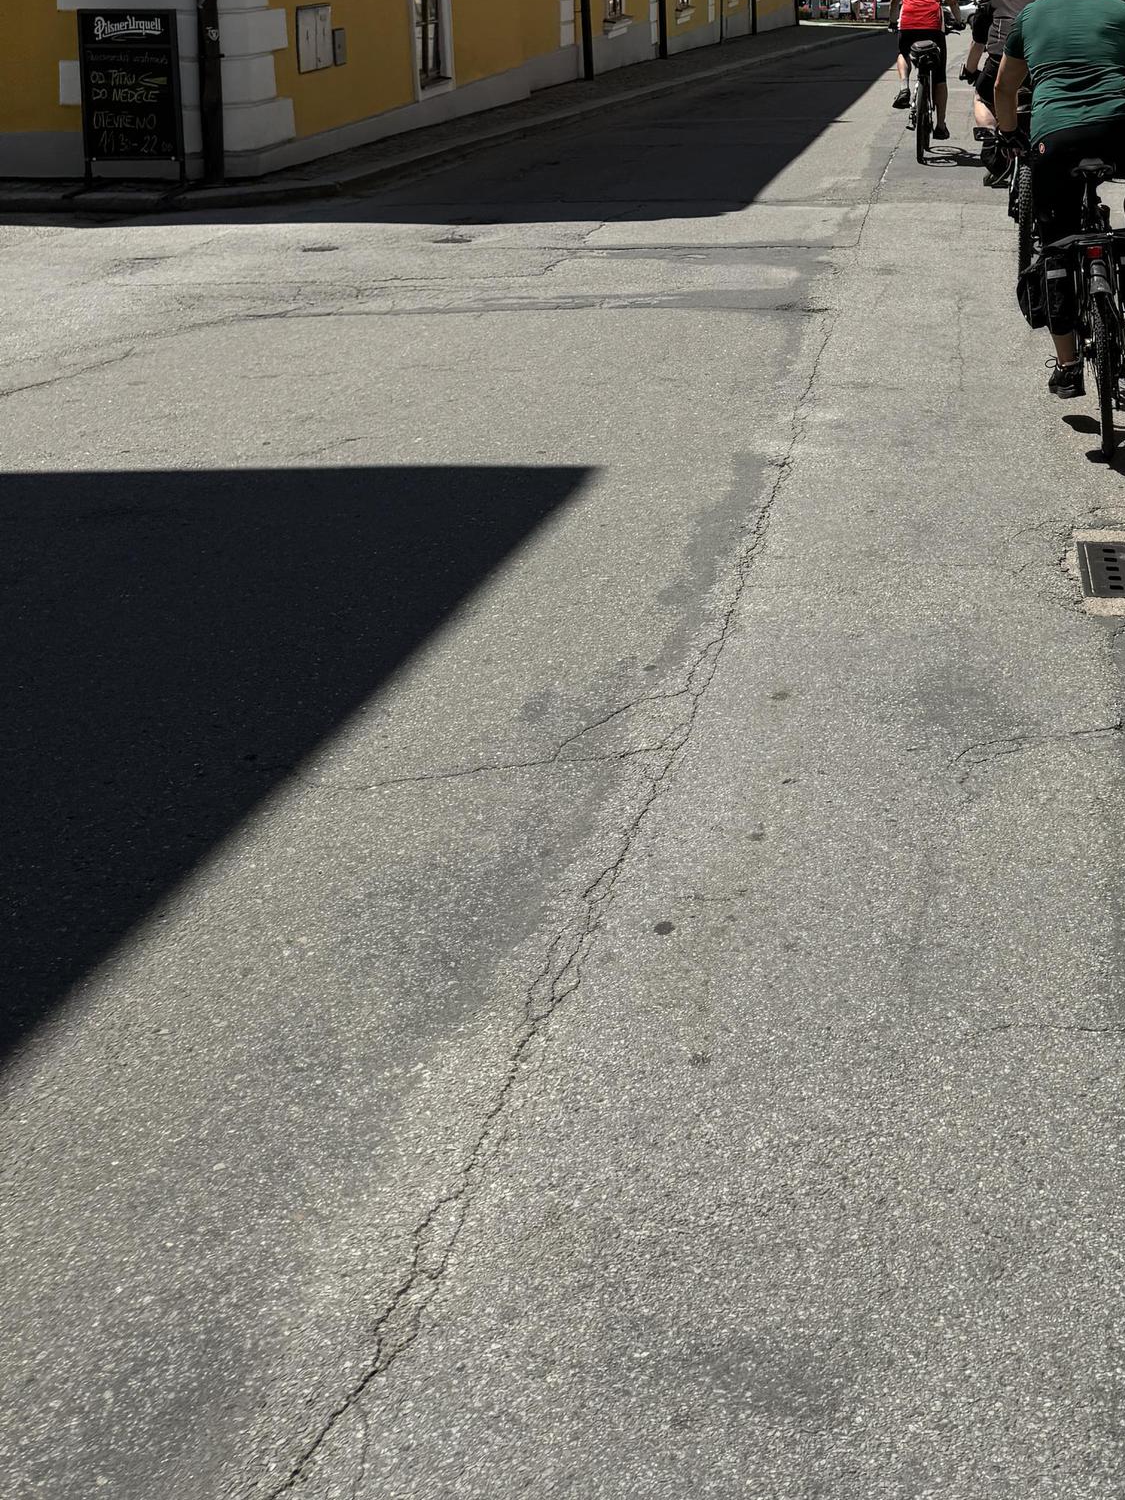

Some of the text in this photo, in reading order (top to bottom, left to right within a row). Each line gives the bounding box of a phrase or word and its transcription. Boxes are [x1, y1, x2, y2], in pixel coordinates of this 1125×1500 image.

[94, 15, 162, 41] Pilsner Urquell
[92, 87, 108, 101] DO
